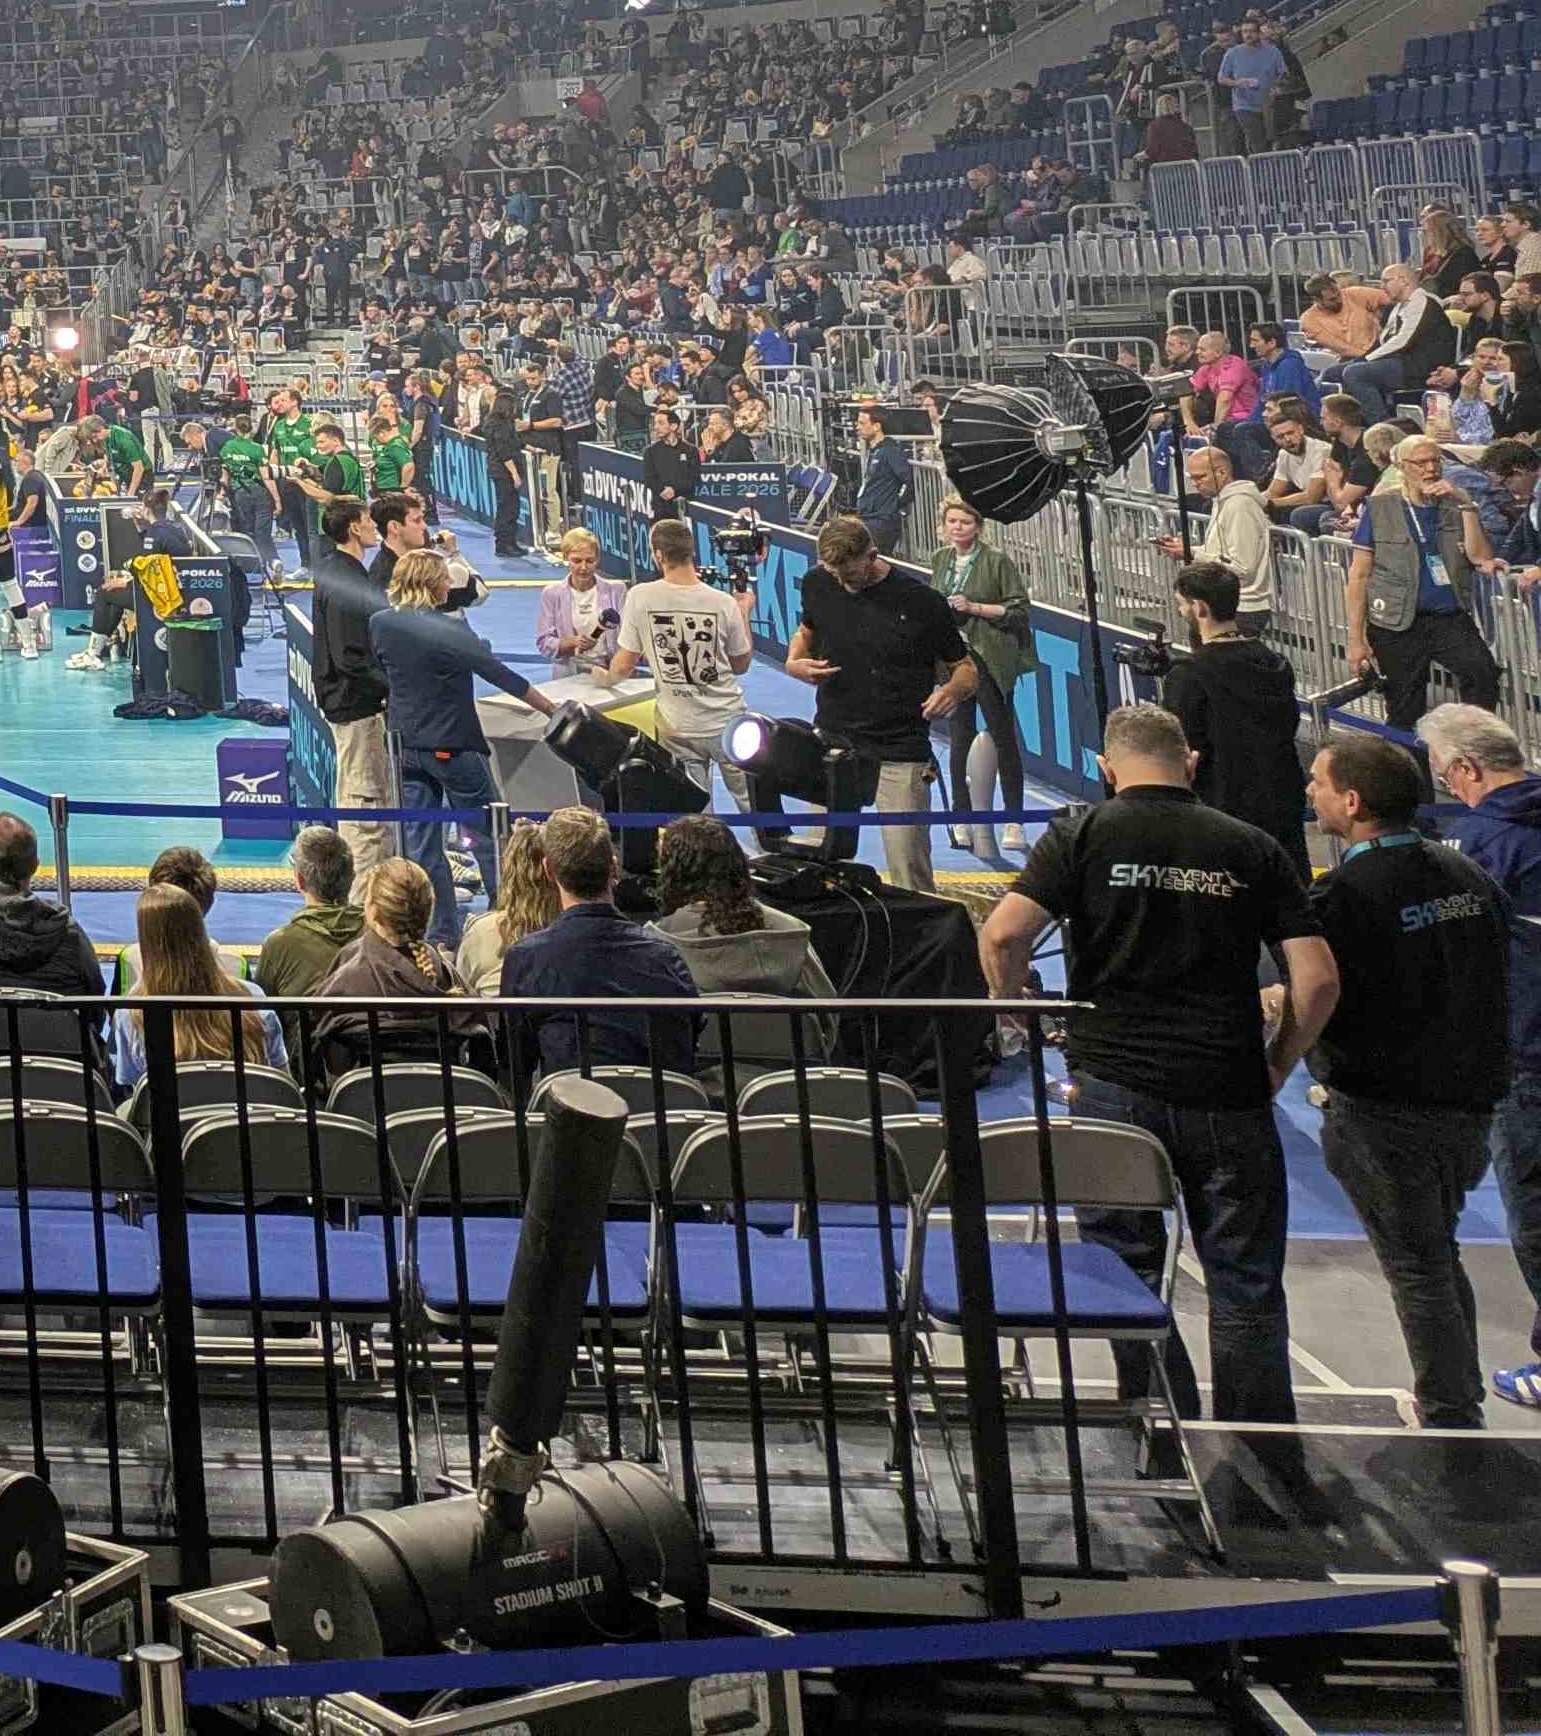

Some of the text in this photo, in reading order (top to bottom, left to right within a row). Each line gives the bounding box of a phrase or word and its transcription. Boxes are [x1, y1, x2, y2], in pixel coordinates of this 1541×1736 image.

[189, 578, 223, 589] 2026
[1108, 863, 1223, 888] SKY EVENT
[1163, 878, 1235, 898] SERVICE
[493, 1575, 604, 1614] STADIUM SHOT II
